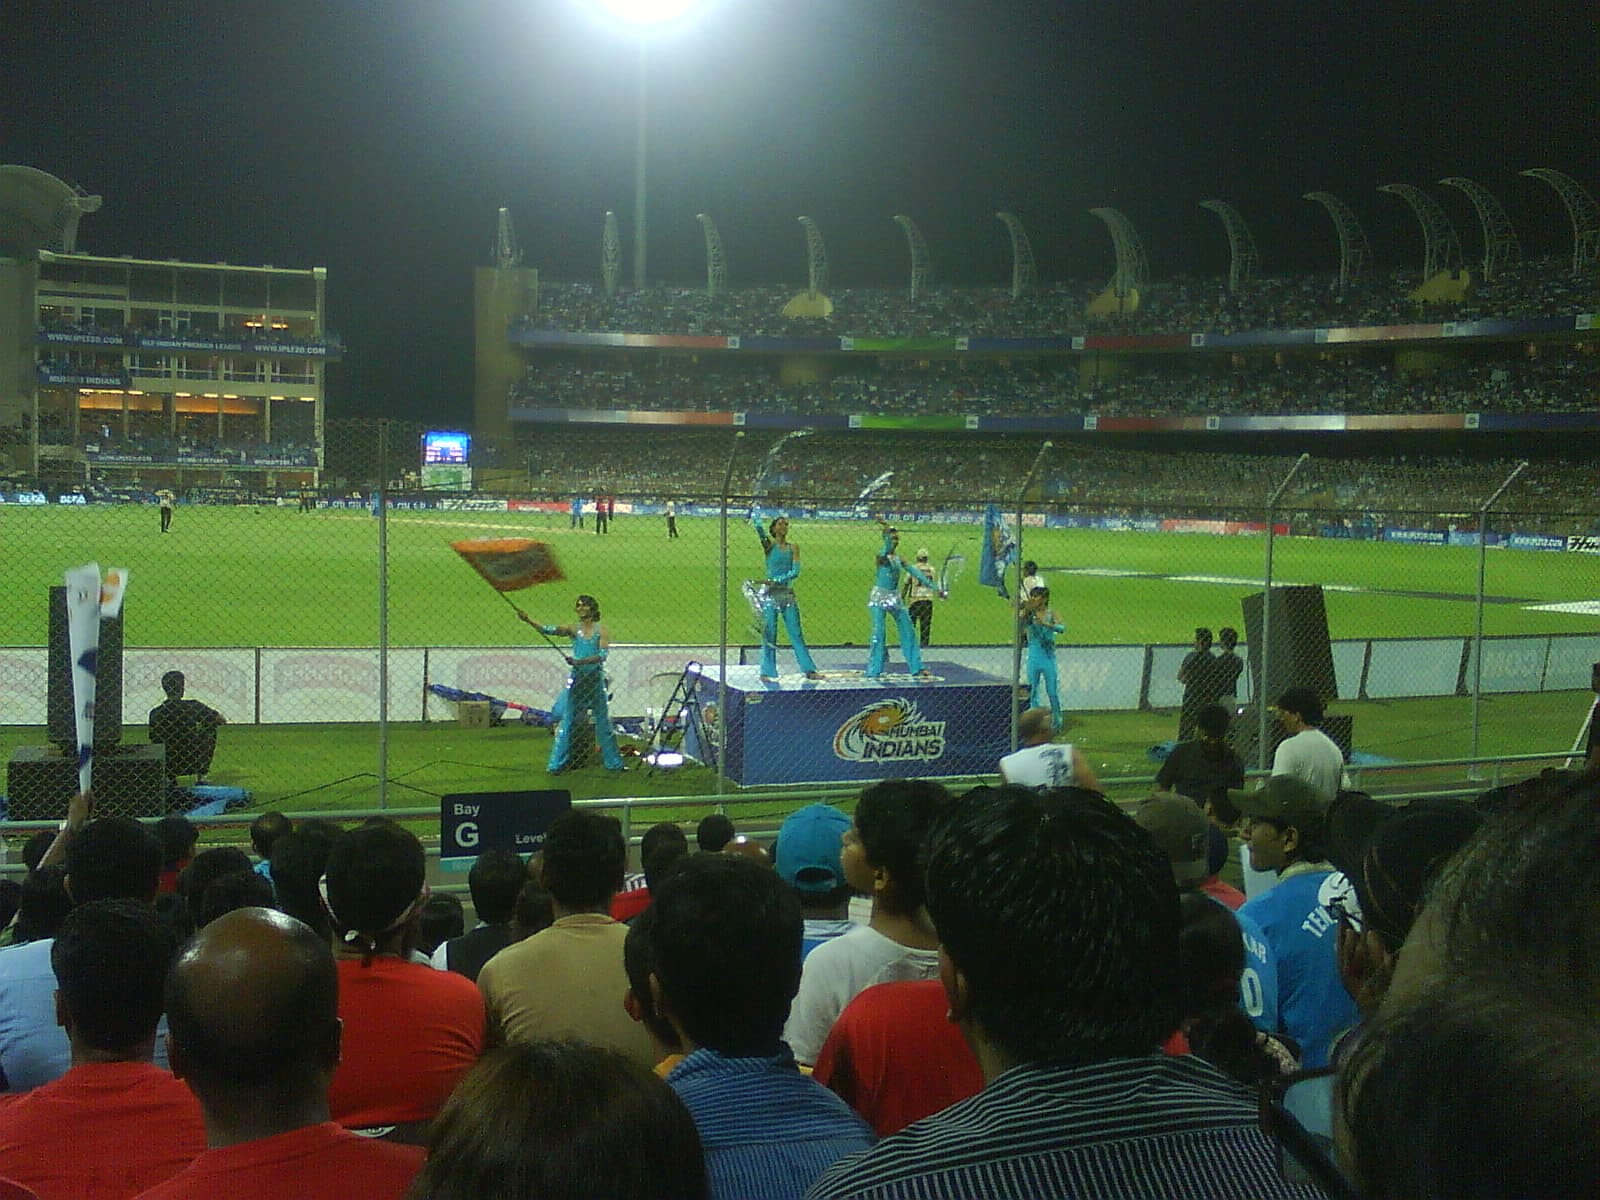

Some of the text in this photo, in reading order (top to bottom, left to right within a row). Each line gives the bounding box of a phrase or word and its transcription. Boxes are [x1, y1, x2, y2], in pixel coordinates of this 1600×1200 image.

[86, 376, 121, 385] INDIANS
[888, 723, 942, 738] MUMBAI
[862, 739, 942, 759] INDIANS
[453, 803, 480, 817] Bay
[455, 821, 480, 848] G
